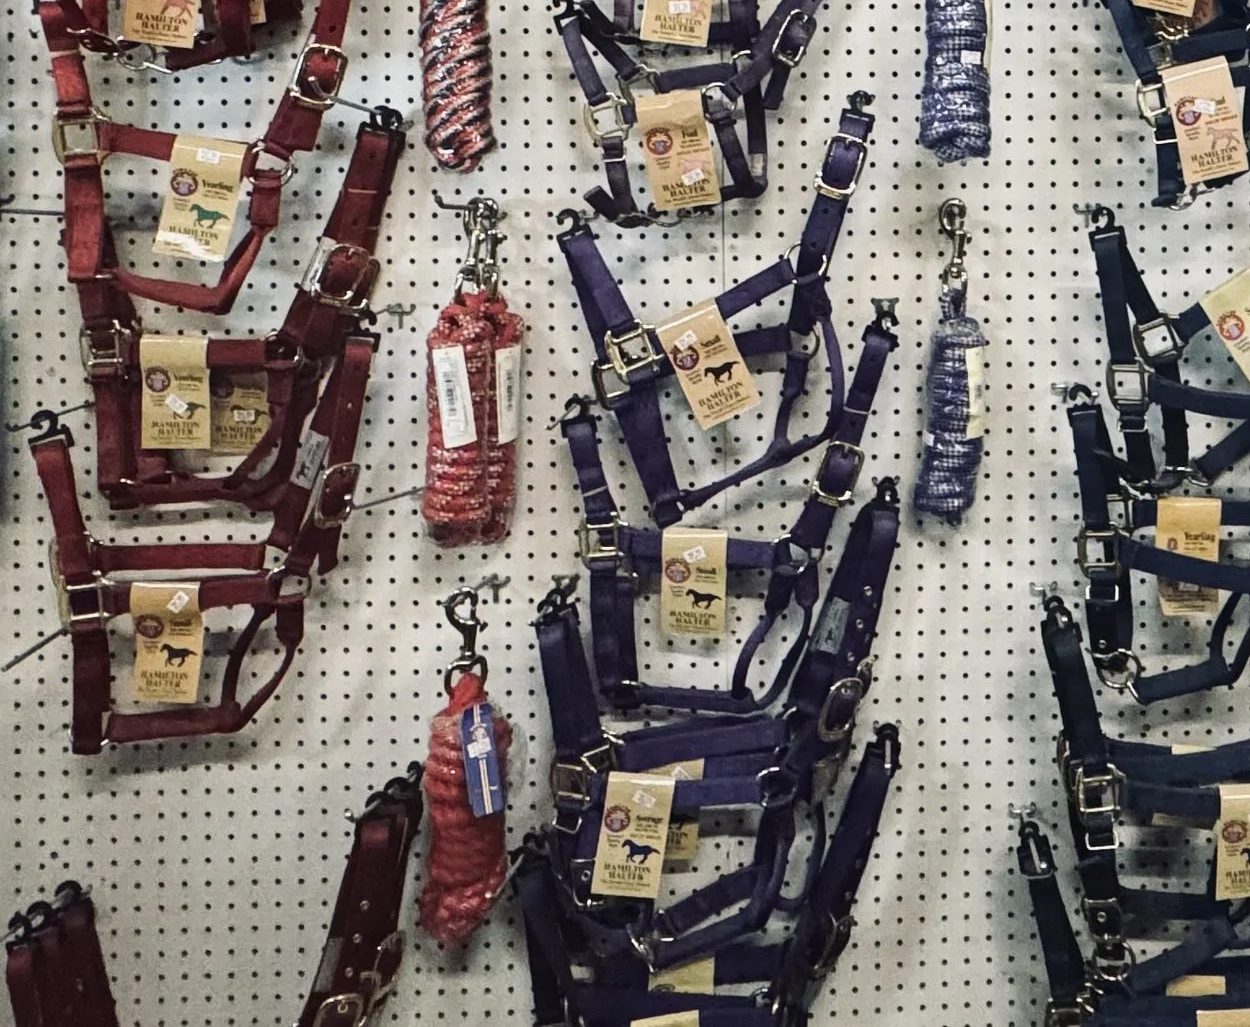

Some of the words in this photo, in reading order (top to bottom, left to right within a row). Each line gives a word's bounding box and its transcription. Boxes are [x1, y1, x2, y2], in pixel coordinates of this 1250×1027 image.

[135, 12, 188, 26] HAMILTON
[654, 15, 703, 26] HAMILTON
[141, 21, 180, 33] HALTER
[660, 23, 695, 33] HALTER
[1191, 145, 1239, 162] HAMILTON
[1198, 155, 1233, 168] HALTER
[670, 184, 706, 197] HALTER
[698, 381, 744, 408] HAMILTON
[1184, 531, 1216, 543] Yearling
[604, 862, 651, 874] HAMILTON
